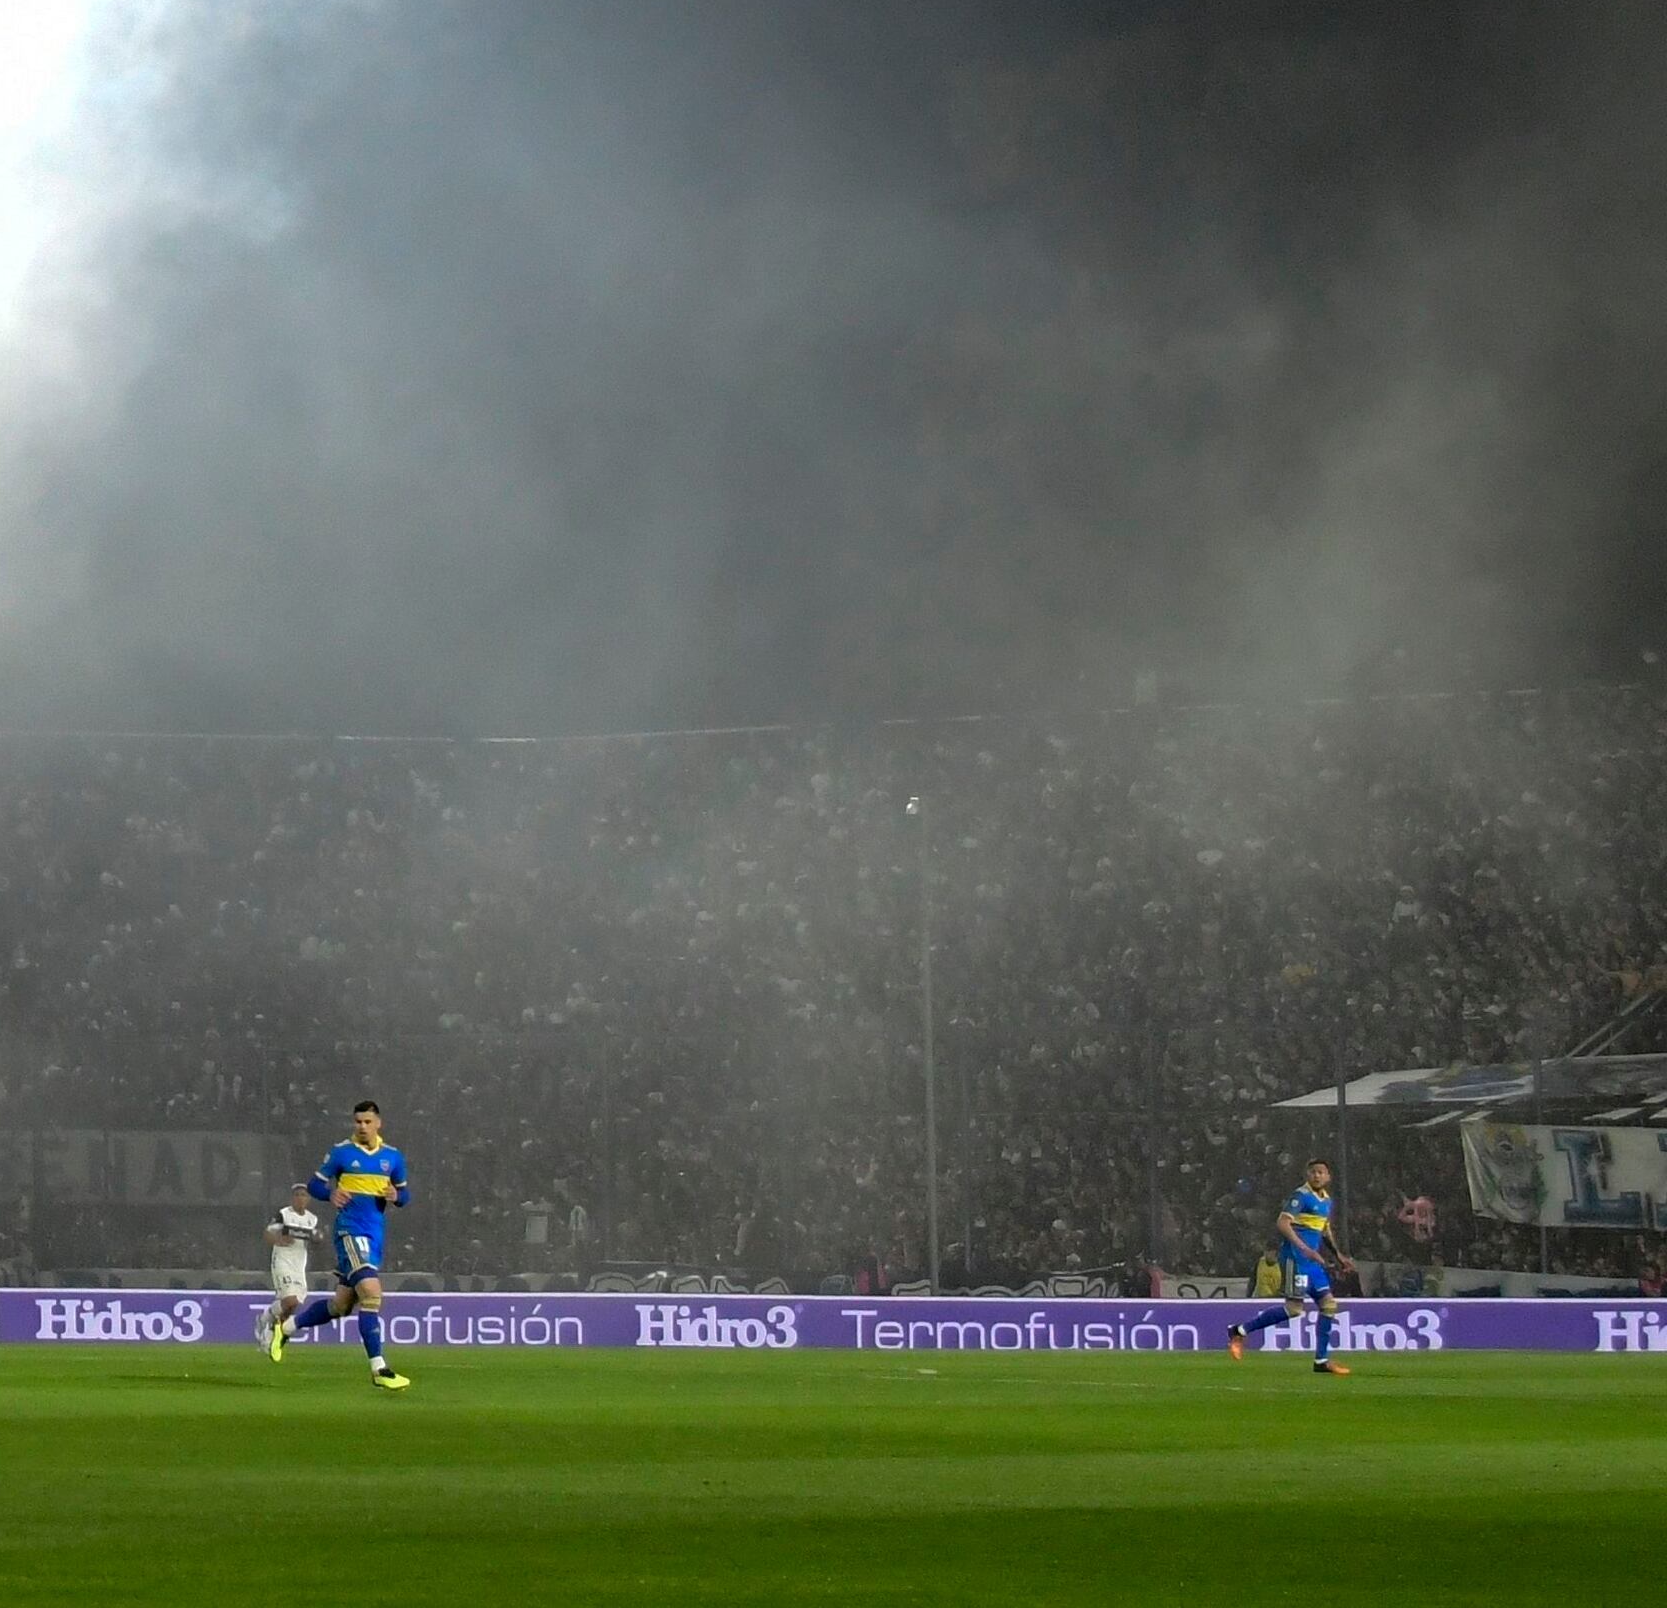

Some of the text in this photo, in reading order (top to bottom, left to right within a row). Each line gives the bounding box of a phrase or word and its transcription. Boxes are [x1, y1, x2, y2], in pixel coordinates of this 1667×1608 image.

[35, 1299, 203, 1342] Hidro3
[635, 1304, 797, 1347] Hidro3
[841, 1309, 1199, 1350] Termofusión
[1593, 1311, 1667, 1351] Hi
